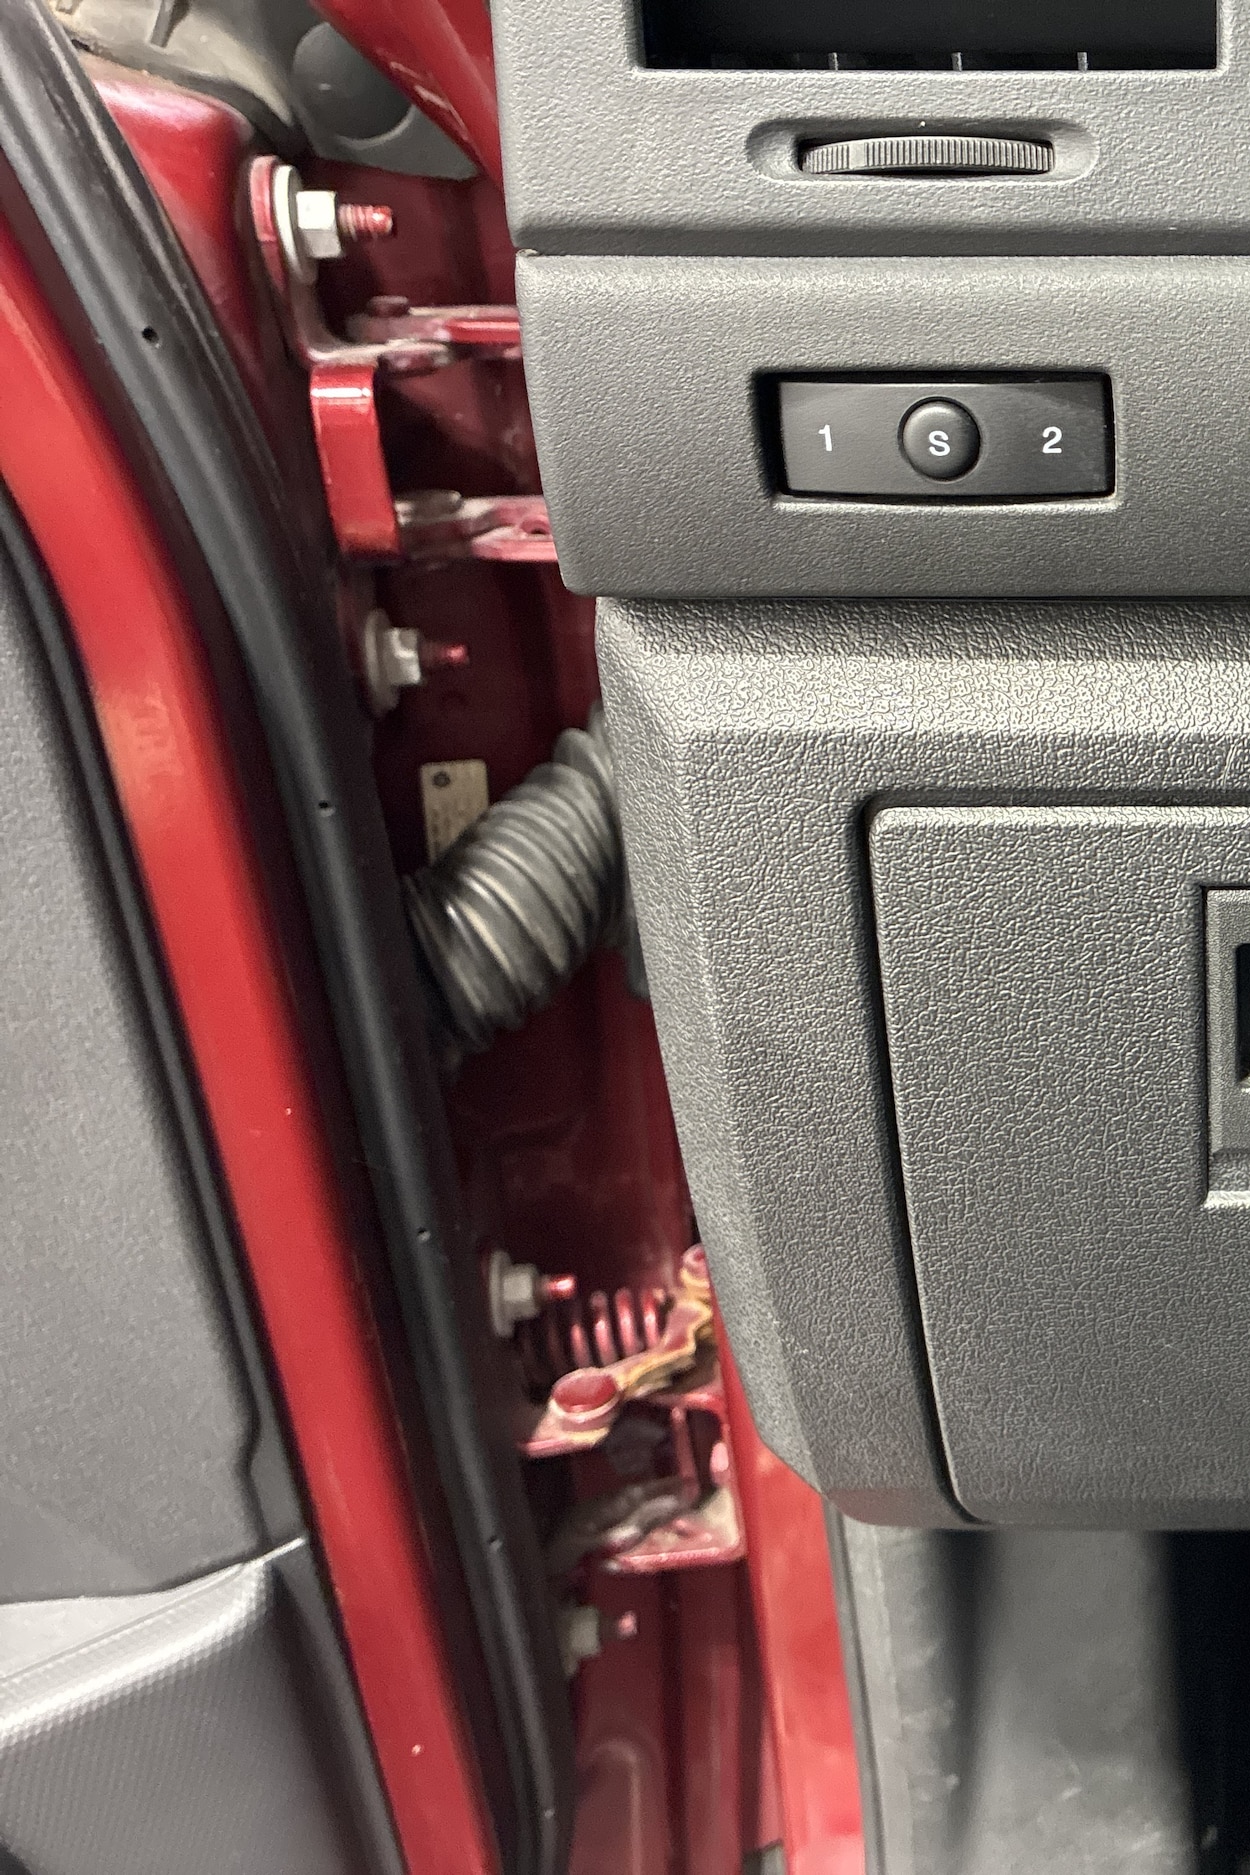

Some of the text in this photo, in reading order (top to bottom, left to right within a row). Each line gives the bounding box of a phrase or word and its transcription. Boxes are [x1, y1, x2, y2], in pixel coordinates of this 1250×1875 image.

[818, 424, 1063, 457] 1 S 2
